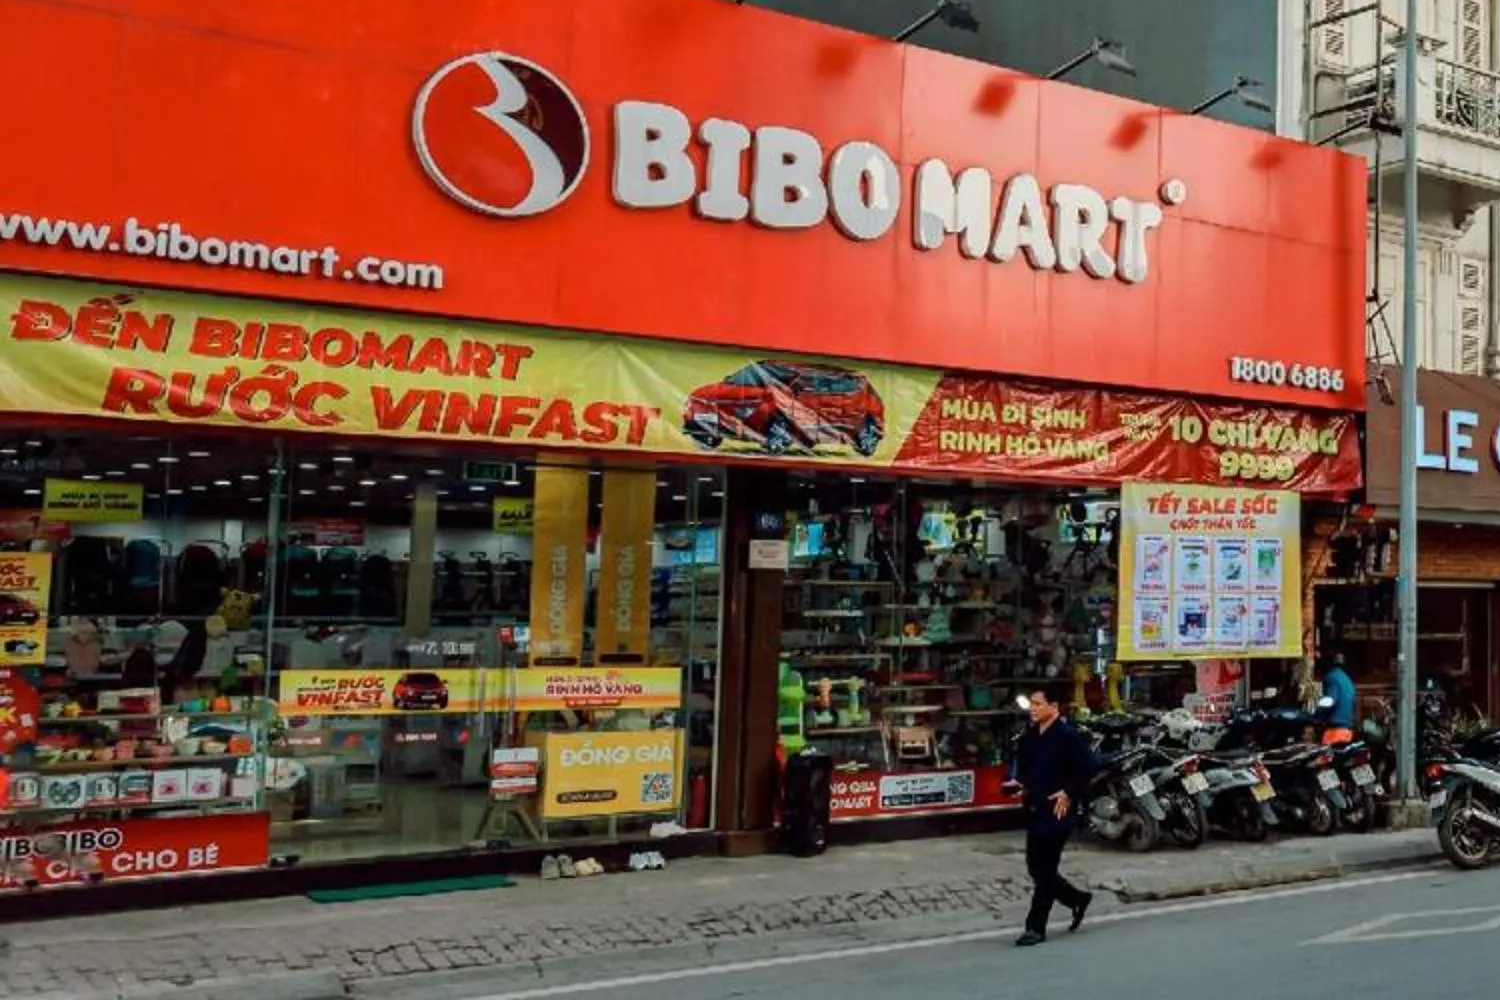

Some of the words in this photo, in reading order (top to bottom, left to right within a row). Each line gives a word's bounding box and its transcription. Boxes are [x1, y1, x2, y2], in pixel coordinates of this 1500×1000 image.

[612, 100, 901, 240] BIBO
[912, 158, 1162, 284] MART
[10, 291, 175, 354] ĐẾN
[189, 316, 535, 381] BIBOMART
[1231, 355, 1286, 386] 1800
[1290, 363, 1345, 392] 6886
[101, 364, 351, 428] RƯỚC
[370, 385, 662, 447] VINFAST
[1031, 404, 1087, 429] SINH
[940, 430, 1001, 454] RINH
[1169, 415, 1202, 443] 10
[1415, 404, 1480, 474] LE
[1219, 450, 1295, 480] 9999
[1147, 490, 1183, 514] TẾT
[1185, 497, 1237, 515] SALE
[1240, 492, 1278, 515] SỐC
[296, 689, 385, 708] VINFAST
[111, 849, 178, 873] CHO
[187, 842, 220, 867] BÉ
